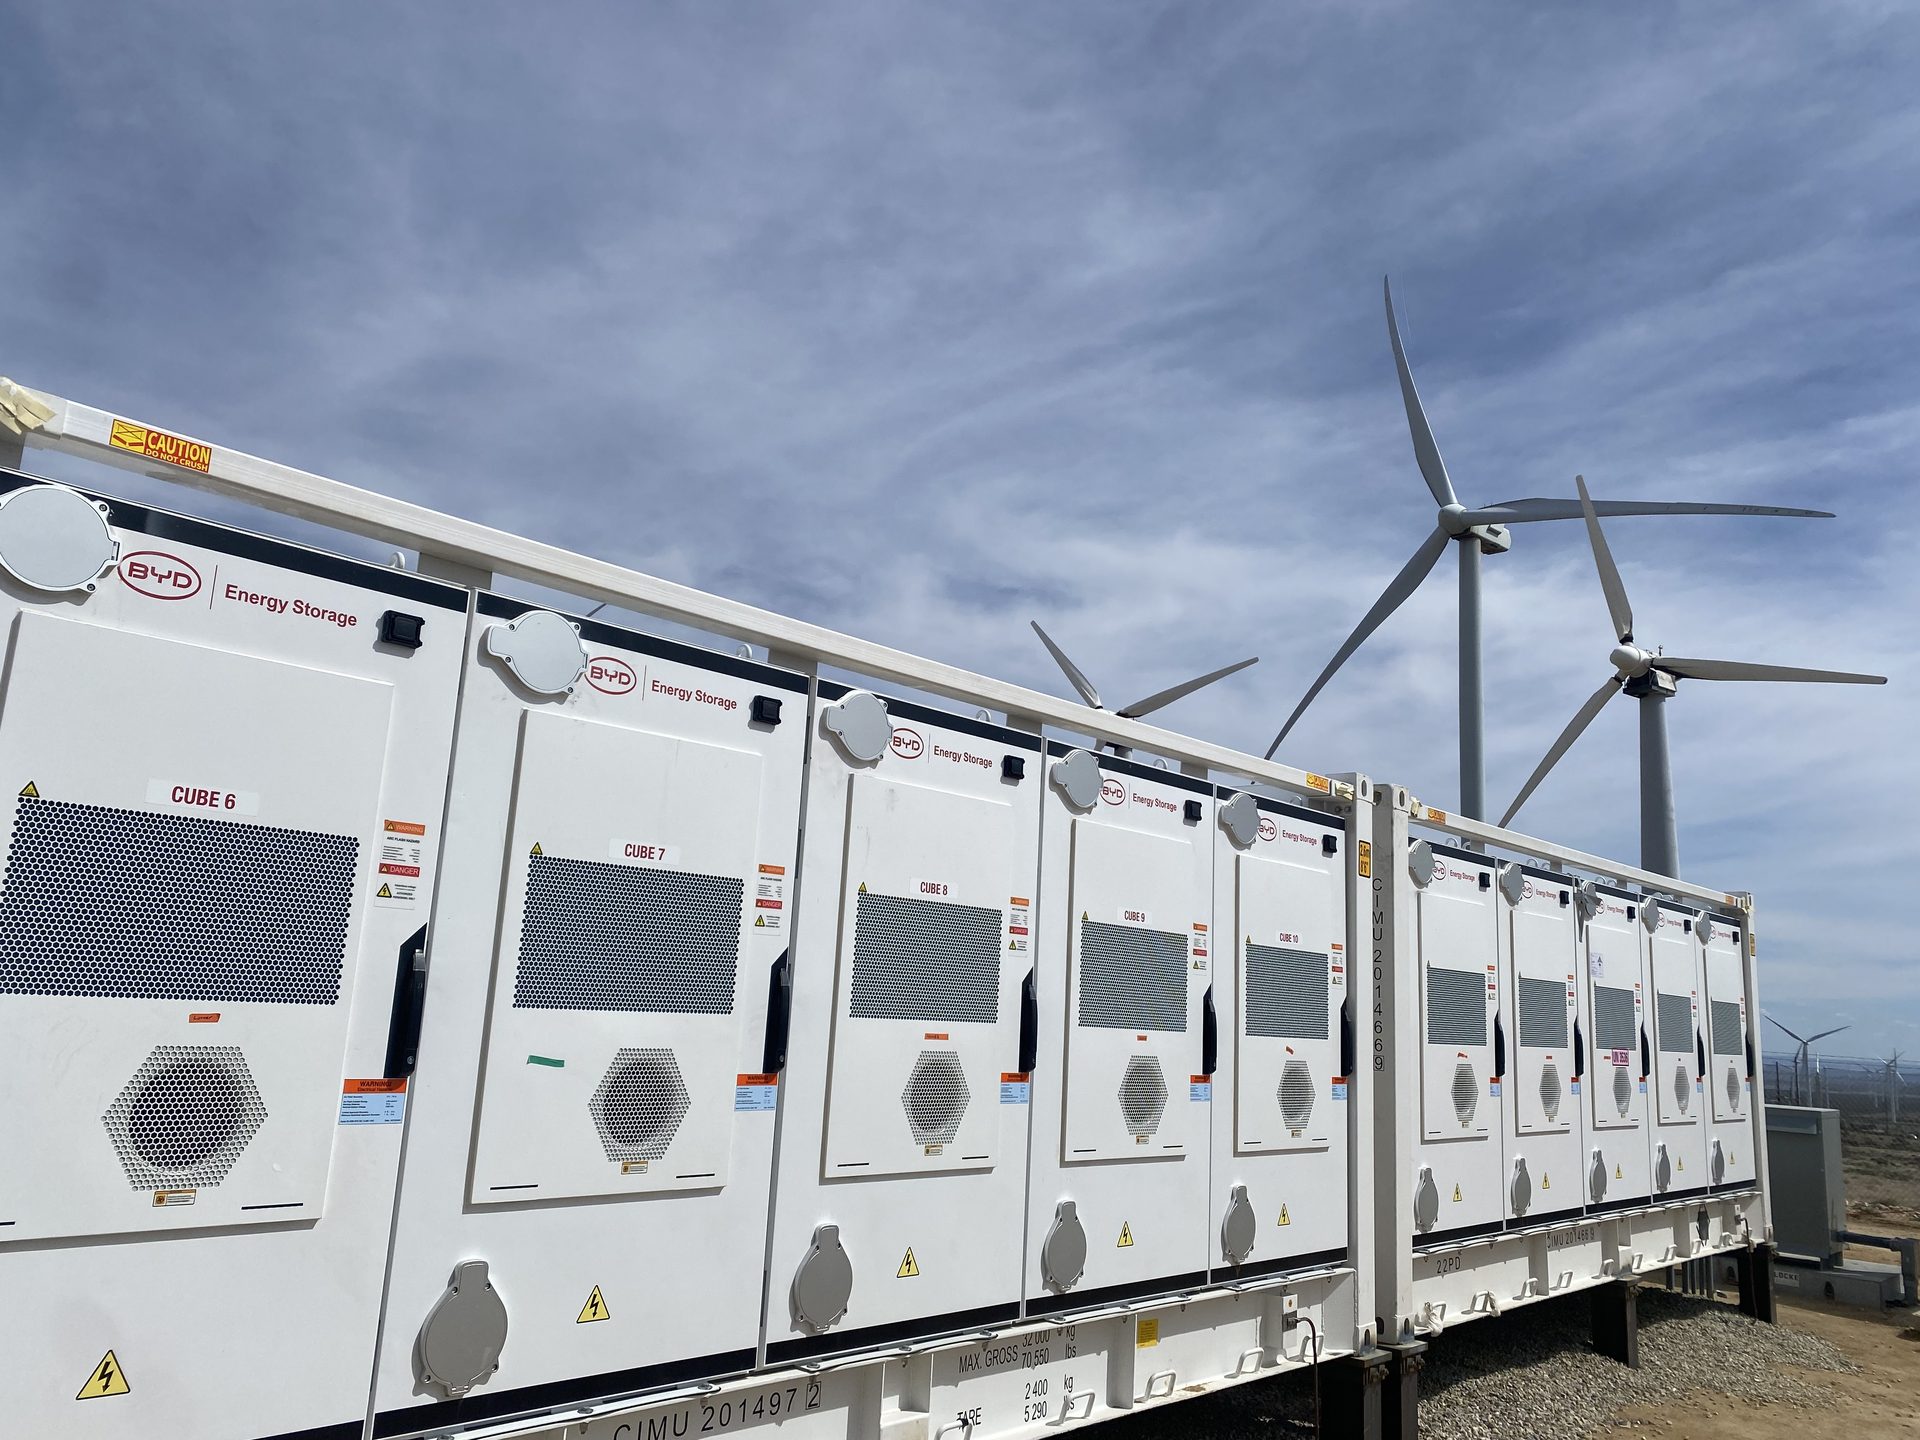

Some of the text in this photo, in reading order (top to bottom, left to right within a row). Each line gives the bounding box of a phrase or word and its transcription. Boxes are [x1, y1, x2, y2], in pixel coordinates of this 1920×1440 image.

[146, 448, 208, 472] DO NOT CRUSH
[147, 432, 211, 465] CAUTION
[128, 561, 358, 628] BYD Energy Storage
[590, 665, 738, 711] BYD Energy Storage
[893, 735, 993, 769] BYD Energy Storage
[171, 786, 236, 810] CUBE 6
[1132, 793, 1154, 808] Energy
[1154, 798, 1178, 812] Storage
[624, 843, 666, 861] CUBE 7
[390, 865, 419, 876] DANGER
[920, 881, 948, 896] CUBE 8
[1124, 910, 1146, 923] CUBE 9
[1279, 932, 1292, 943] CUBE
[1372, 878, 1384, 1070] CIMU 201466 9
[959, 1352, 982, 1374] MAX.
[985, 1344, 1019, 1368] GROSS
[1022, 1332, 1033, 1348] 32
[1066, 1324, 1076, 1342] kg
[1021, 1343, 1077, 1370] 70 550 lbs
[1025, 1373, 1074, 1400] 2 400 kg
[613, 1384, 820, 1440] CIMU 201497 2
[1024, 1404, 1030, 1423] 5
[1031, 1400, 1048, 1421] 290
